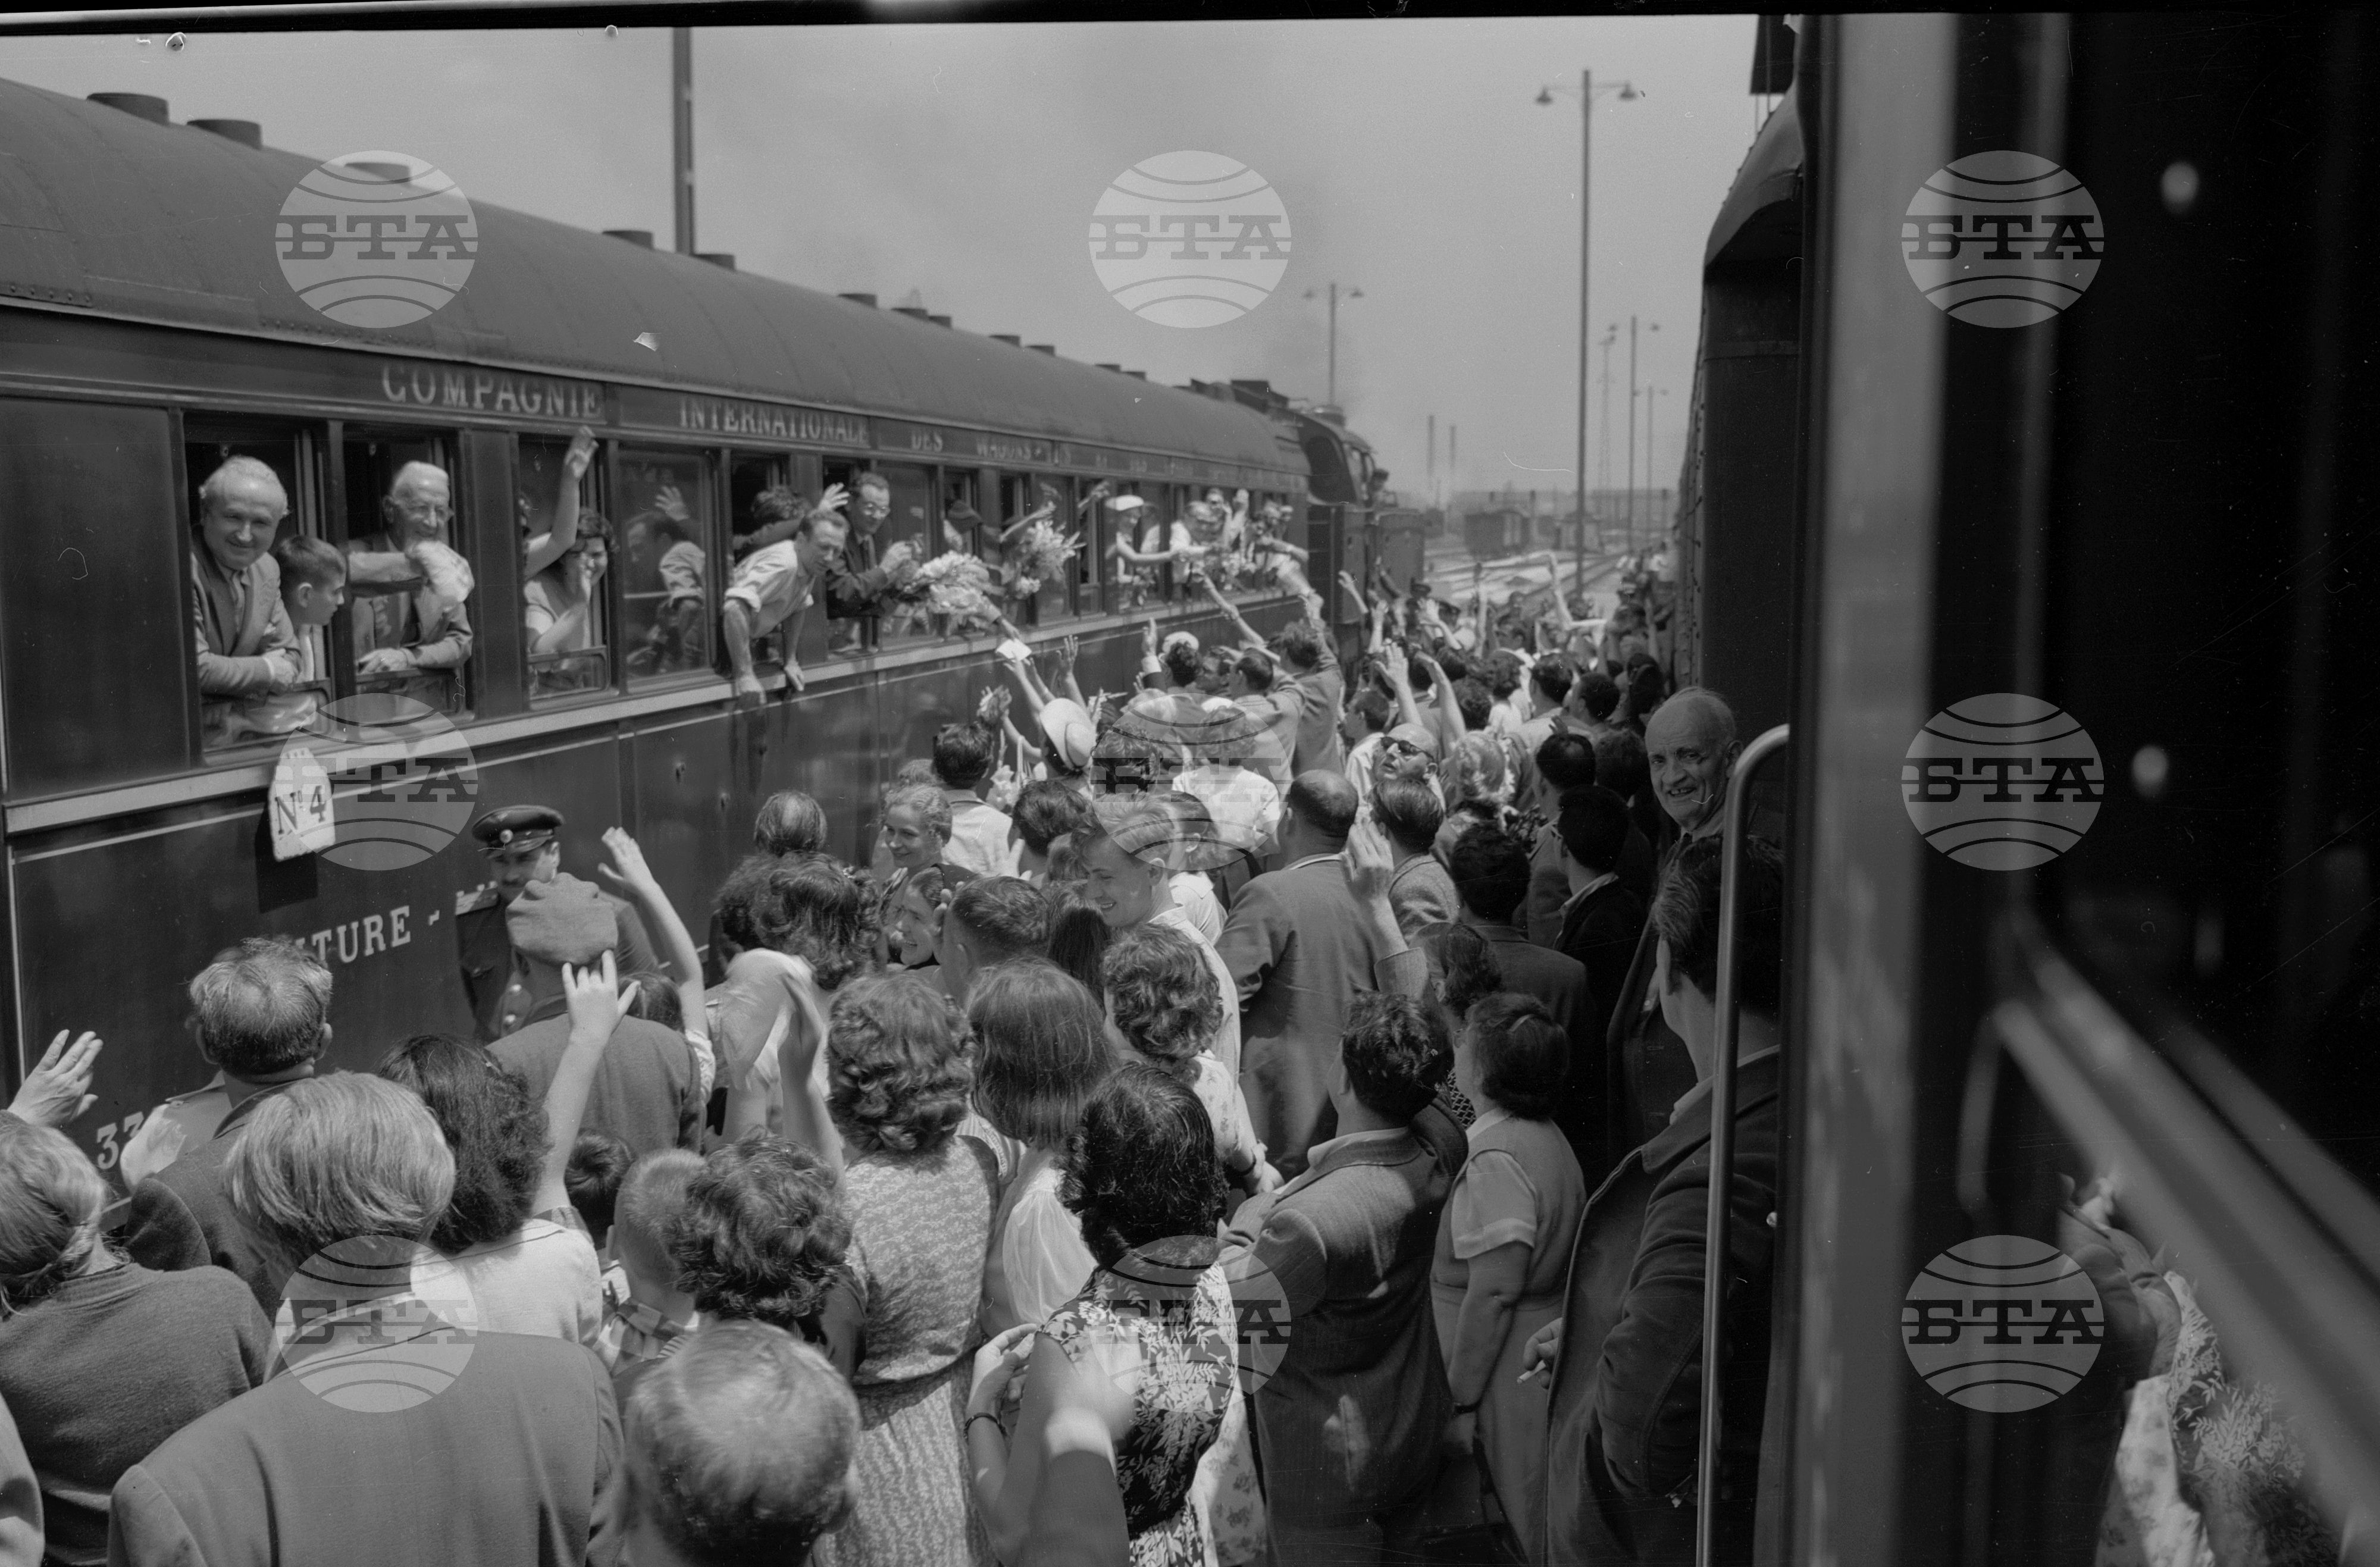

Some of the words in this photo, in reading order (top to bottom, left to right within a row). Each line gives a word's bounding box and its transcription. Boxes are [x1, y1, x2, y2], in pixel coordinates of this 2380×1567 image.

[382, 362, 602, 417] COMPAGNIE
[679, 399, 869, 444] INTERNATIONALE
[310, 785, 327, 823] 4
[295, 905, 411, 963] TURE
